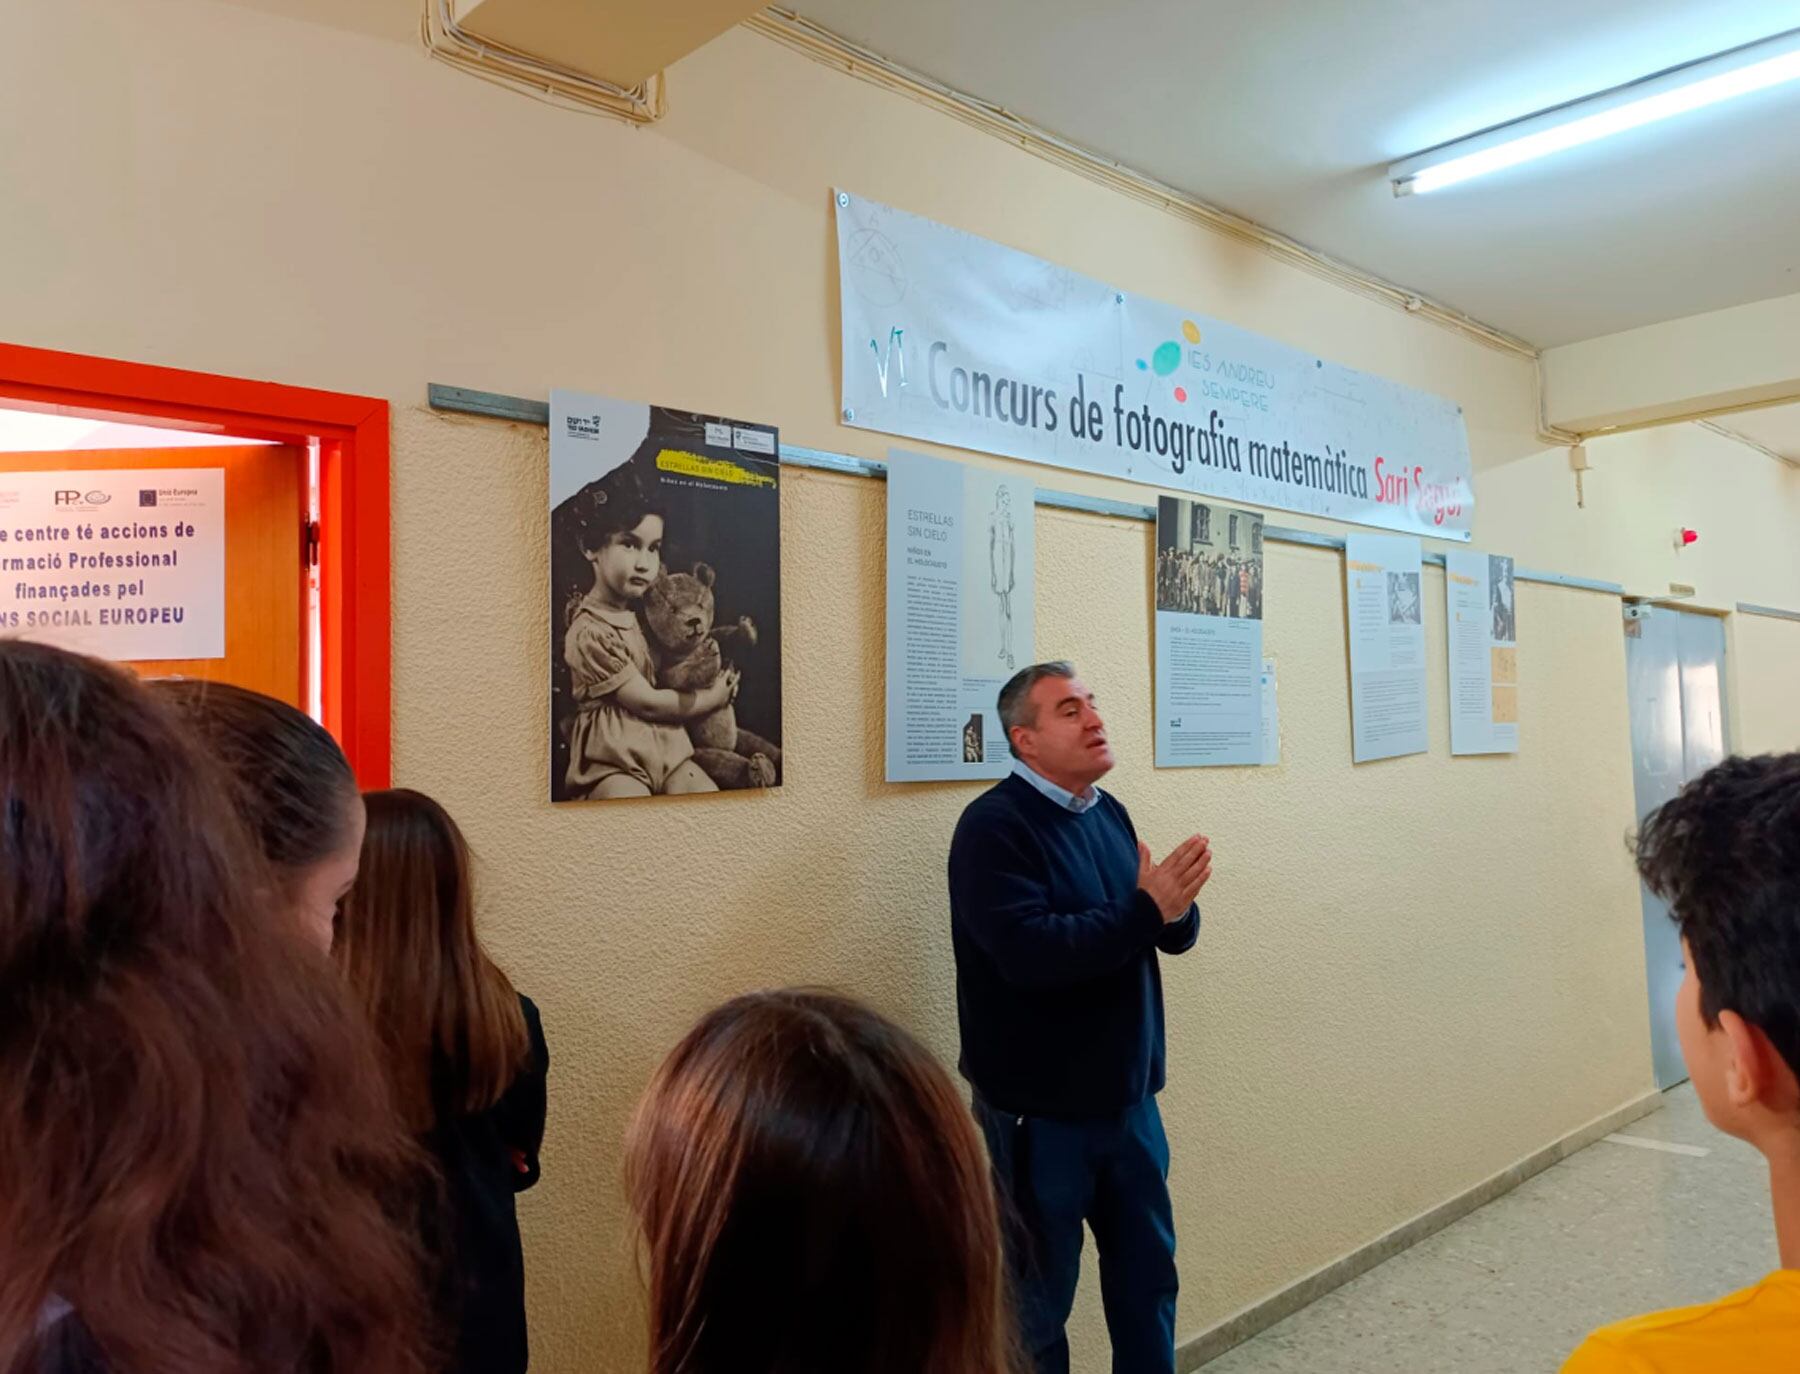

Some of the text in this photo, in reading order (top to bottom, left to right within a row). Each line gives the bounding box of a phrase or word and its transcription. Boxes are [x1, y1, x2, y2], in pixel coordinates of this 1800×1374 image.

[1188, 350, 1276, 390] IES ANDREU
[1202, 380, 1269, 411] SEMPERE
[929, 341, 1058, 431] Concurs
[1070, 374, 1104, 442] de
[1113, 384, 1242, 475] fotografia
[1248, 441, 1368, 500] matemàtica
[1375, 457, 1409, 506] Sari
[908, 509, 954, 527] ESTRELLAS
[15, 525, 70, 541] centre
[77, 524, 93, 540] té
[100, 523, 168, 540] accions
[175, 521, 194, 537] de
[907, 525, 948, 542] SIN CIELO
[69, 550, 177, 569] Professional
[15, 580, 144, 602] finançades pel
[26, 609, 92, 627] SOCIAL
[99, 607, 185, 625] EUROPEU
